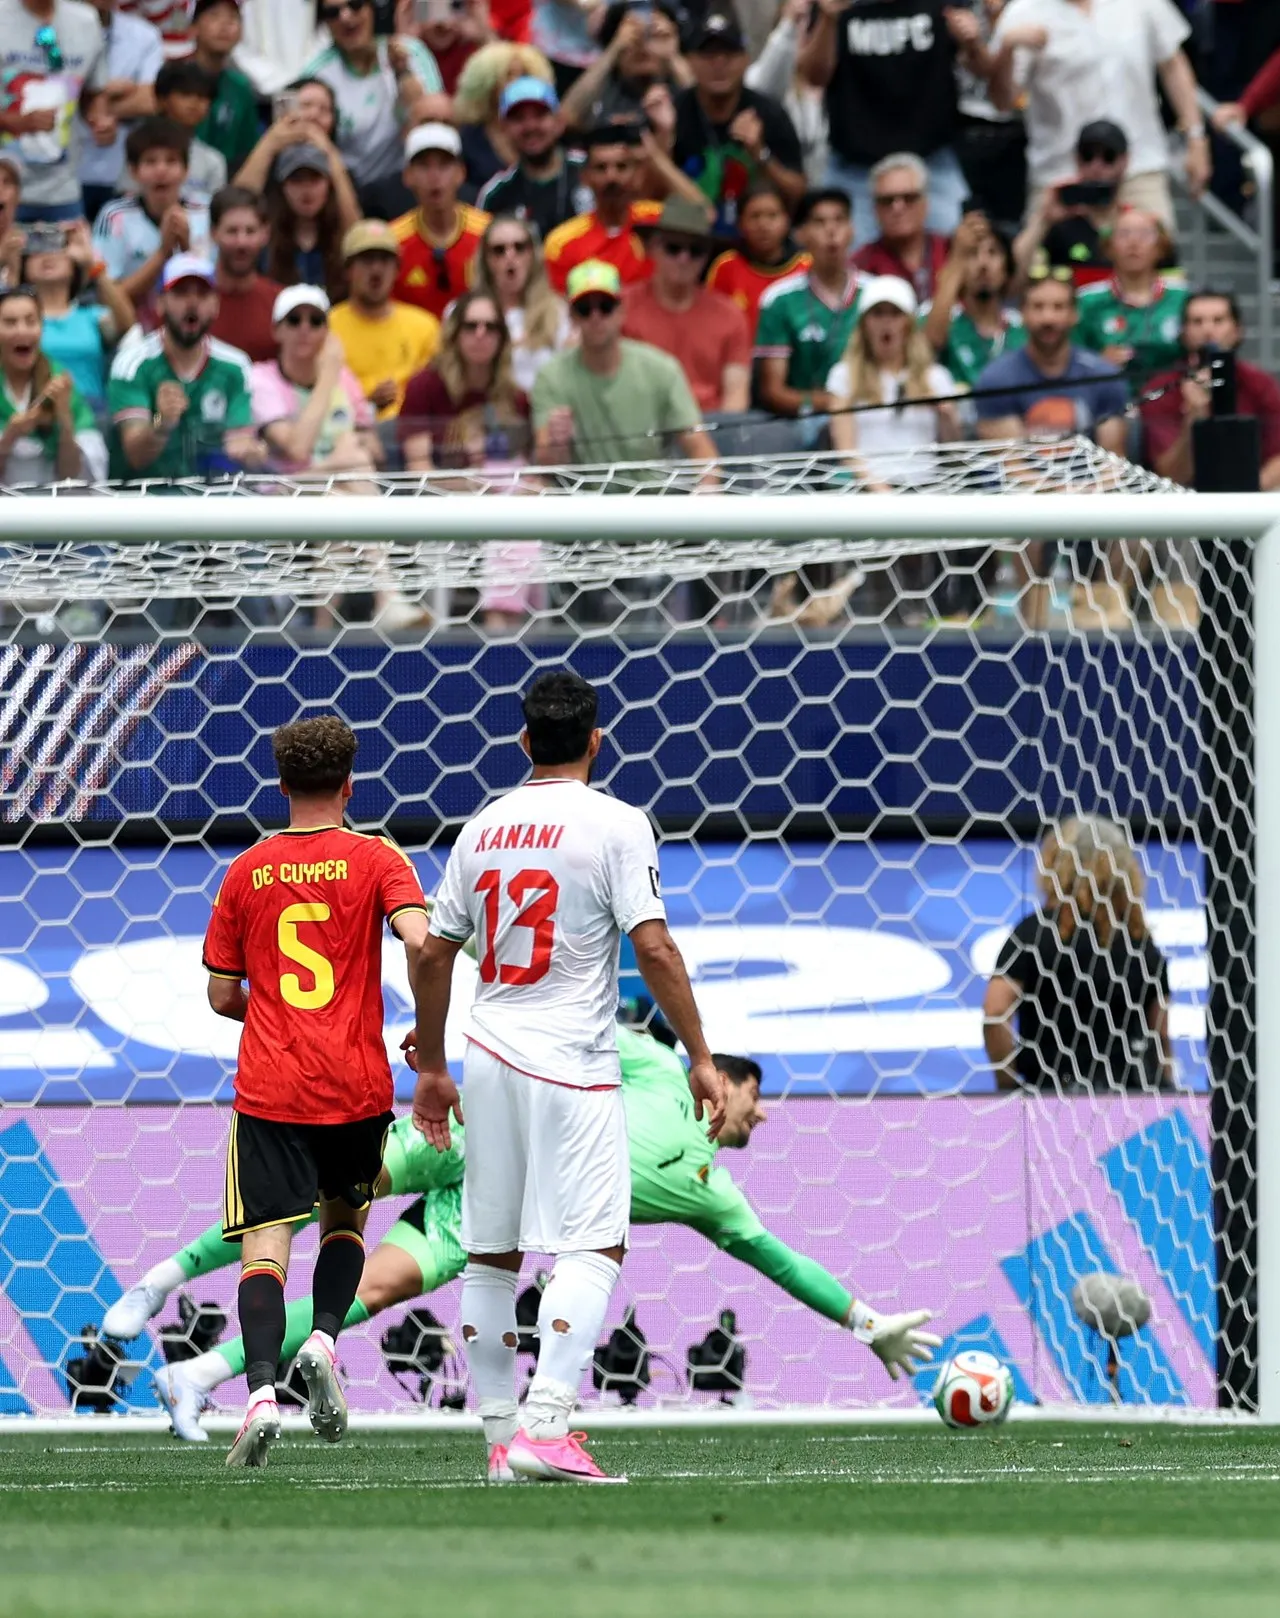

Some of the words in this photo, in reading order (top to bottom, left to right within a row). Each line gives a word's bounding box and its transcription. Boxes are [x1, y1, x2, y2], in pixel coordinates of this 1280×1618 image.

[847, 13, 935, 56] MUFC
[475, 824, 565, 853] KANANI
[252, 864, 274, 890] DE
[280, 860, 348, 884] CUYPER
[474, 869, 559, 985] 13
[278, 903, 335, 1010] 5
